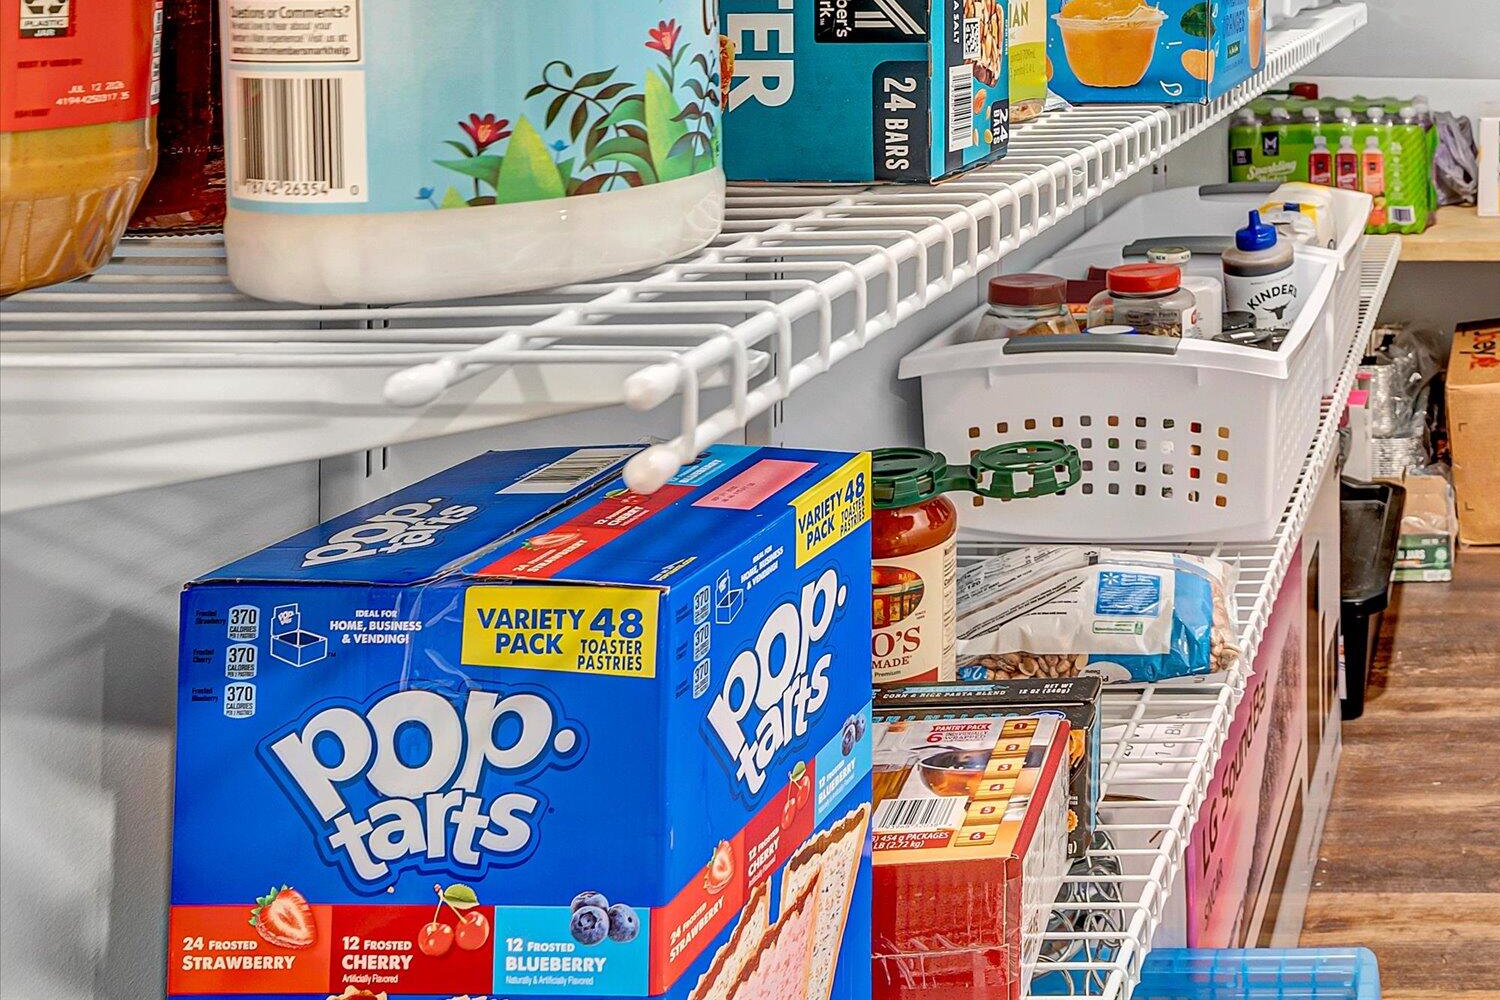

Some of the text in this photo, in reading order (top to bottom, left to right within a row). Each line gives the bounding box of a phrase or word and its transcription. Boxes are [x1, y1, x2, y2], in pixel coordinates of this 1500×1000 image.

[279, 4, 351, 19] Comments?
[952, 12, 960, 44] SALT
[883, 76, 917, 112] 24
[999, 107, 1009, 144] 24
[884, 117, 910, 172] BARS
[284, 182, 328, 196] 26354
[798, 488, 843, 534] VARIETY
[844, 472, 866, 504] 48
[840, 497, 866, 522] TOASTER
[376, 503, 478, 554] tarts
[839, 509, 866, 537] PASTRIES
[806, 518, 836, 551] PACK
[758, 546, 784, 575] BUSINESS
[694, 587, 709, 607] 370
[231, 609, 257, 625] 370
[355, 609, 398, 618] IDEAL FOR
[229, 625, 257, 633] CALORIES
[329, 620, 423, 631] HOME, BUSINESS
[477, 607, 644, 639] VARIETY 48
[341, 634, 409, 644] & VENDING!
[694, 624, 709, 643] 370
[495, 632, 563, 655] PACK
[580, 639, 642, 655] TOASTER
[228, 647, 255, 664] 370
[577, 655, 643, 671] PASTRIES
[694, 660, 709, 679] 370
[874, 670, 902, 678] Premium
[227, 686, 253, 701] 370
[734, 653, 832, 795] tarts
[934, 724, 967, 732] PANTRY
[926, 732, 943, 743] 6
[818, 772, 827, 787] 12
[818, 757, 857, 803] BLUEBERRY
[328, 788, 539, 881] tarts
[880, 831, 950, 842] 454 PACKAGES
[907, 839, 925, 849] kg)
[747, 836, 781, 877] CHERRY
[748, 845, 757, 861] 12
[669, 895, 725, 963] STRAWBERRY
[669, 925, 682, 946] 24
[182, 936, 258, 951] 24 FROSTED
[342, 936, 413, 951] 12 FROSTED
[506, 938, 575, 953] 12 FROSTED
[182, 955, 296, 971] STRAWBERRY
[342, 954, 414, 971] CHERRY
[505, 957, 607, 973] BLUEBERRY
[374, 974, 399, 984] Flavored
